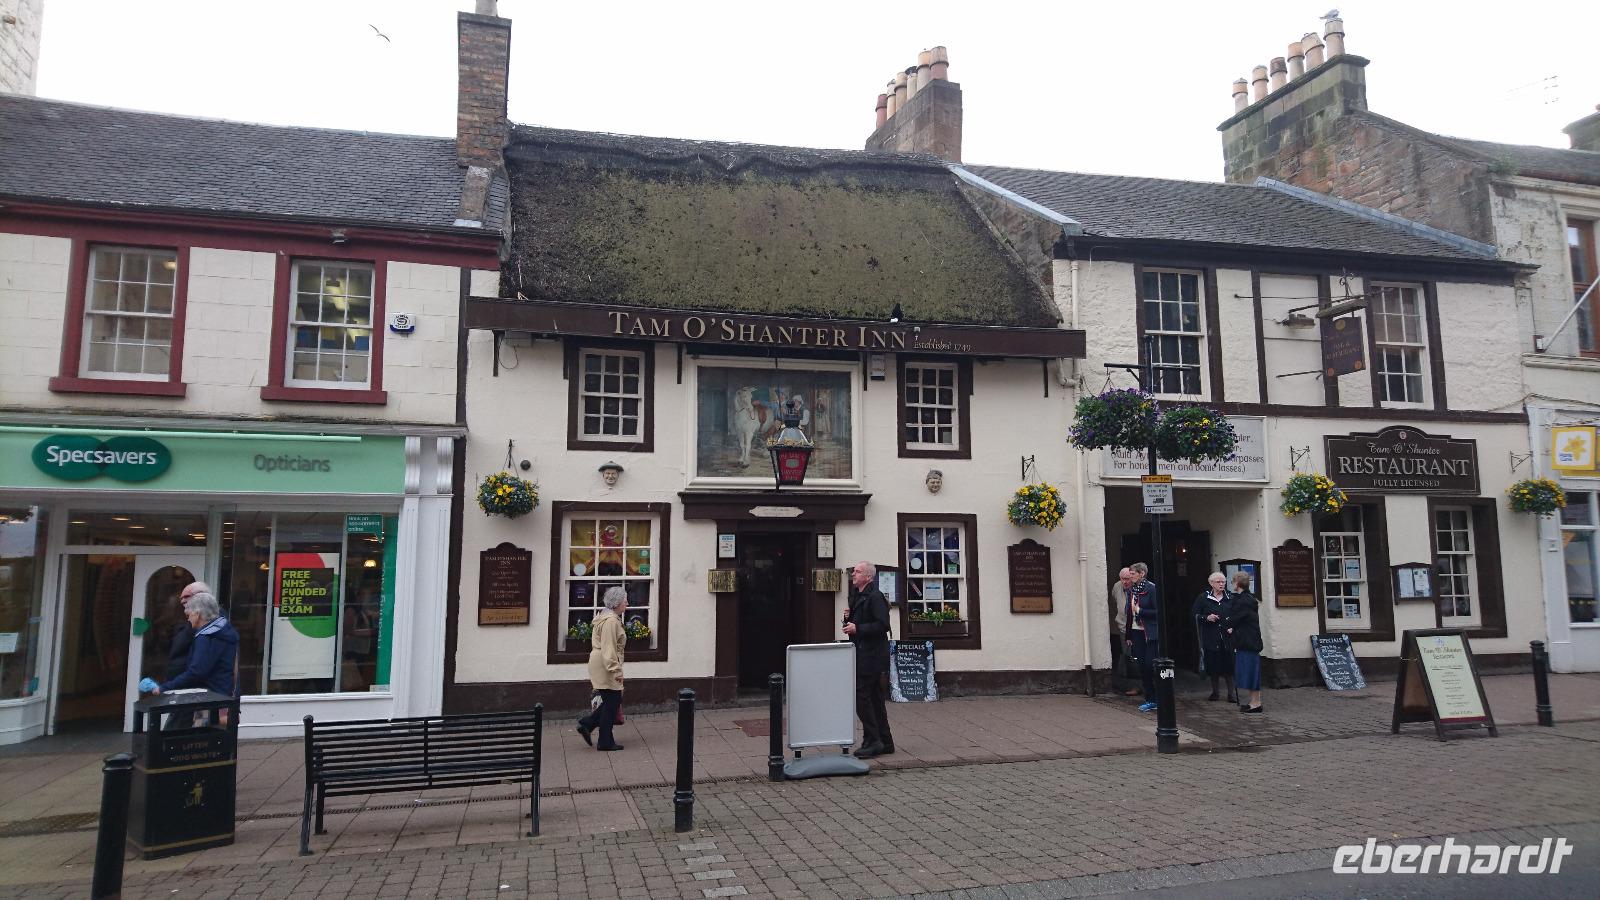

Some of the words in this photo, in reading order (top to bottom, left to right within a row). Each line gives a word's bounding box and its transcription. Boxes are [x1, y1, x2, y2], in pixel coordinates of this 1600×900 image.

[608, 311, 670, 337] TAM
[683, 316, 849, 347] O'SHANTER
[858, 326, 906, 349] INN
[1366, 442, 1391, 455] Tam
[46, 445, 157, 467] Specsavers
[254, 453, 331, 473] Opticians
[1113, 461, 1127, 469] For
[1129, 460, 1149, 470] hone
[1158, 463, 1176, 471] men
[1338, 456, 1470, 477] RESTAURANT
[1373, 479, 1398, 487] FULLY
[1400, 479, 1441, 488] LICENSED
[282, 570, 311, 579] FREE
[281, 587, 327, 596] FUNDED
[281, 596, 303, 605] EYE
[280, 605, 313, 614] EXAM
